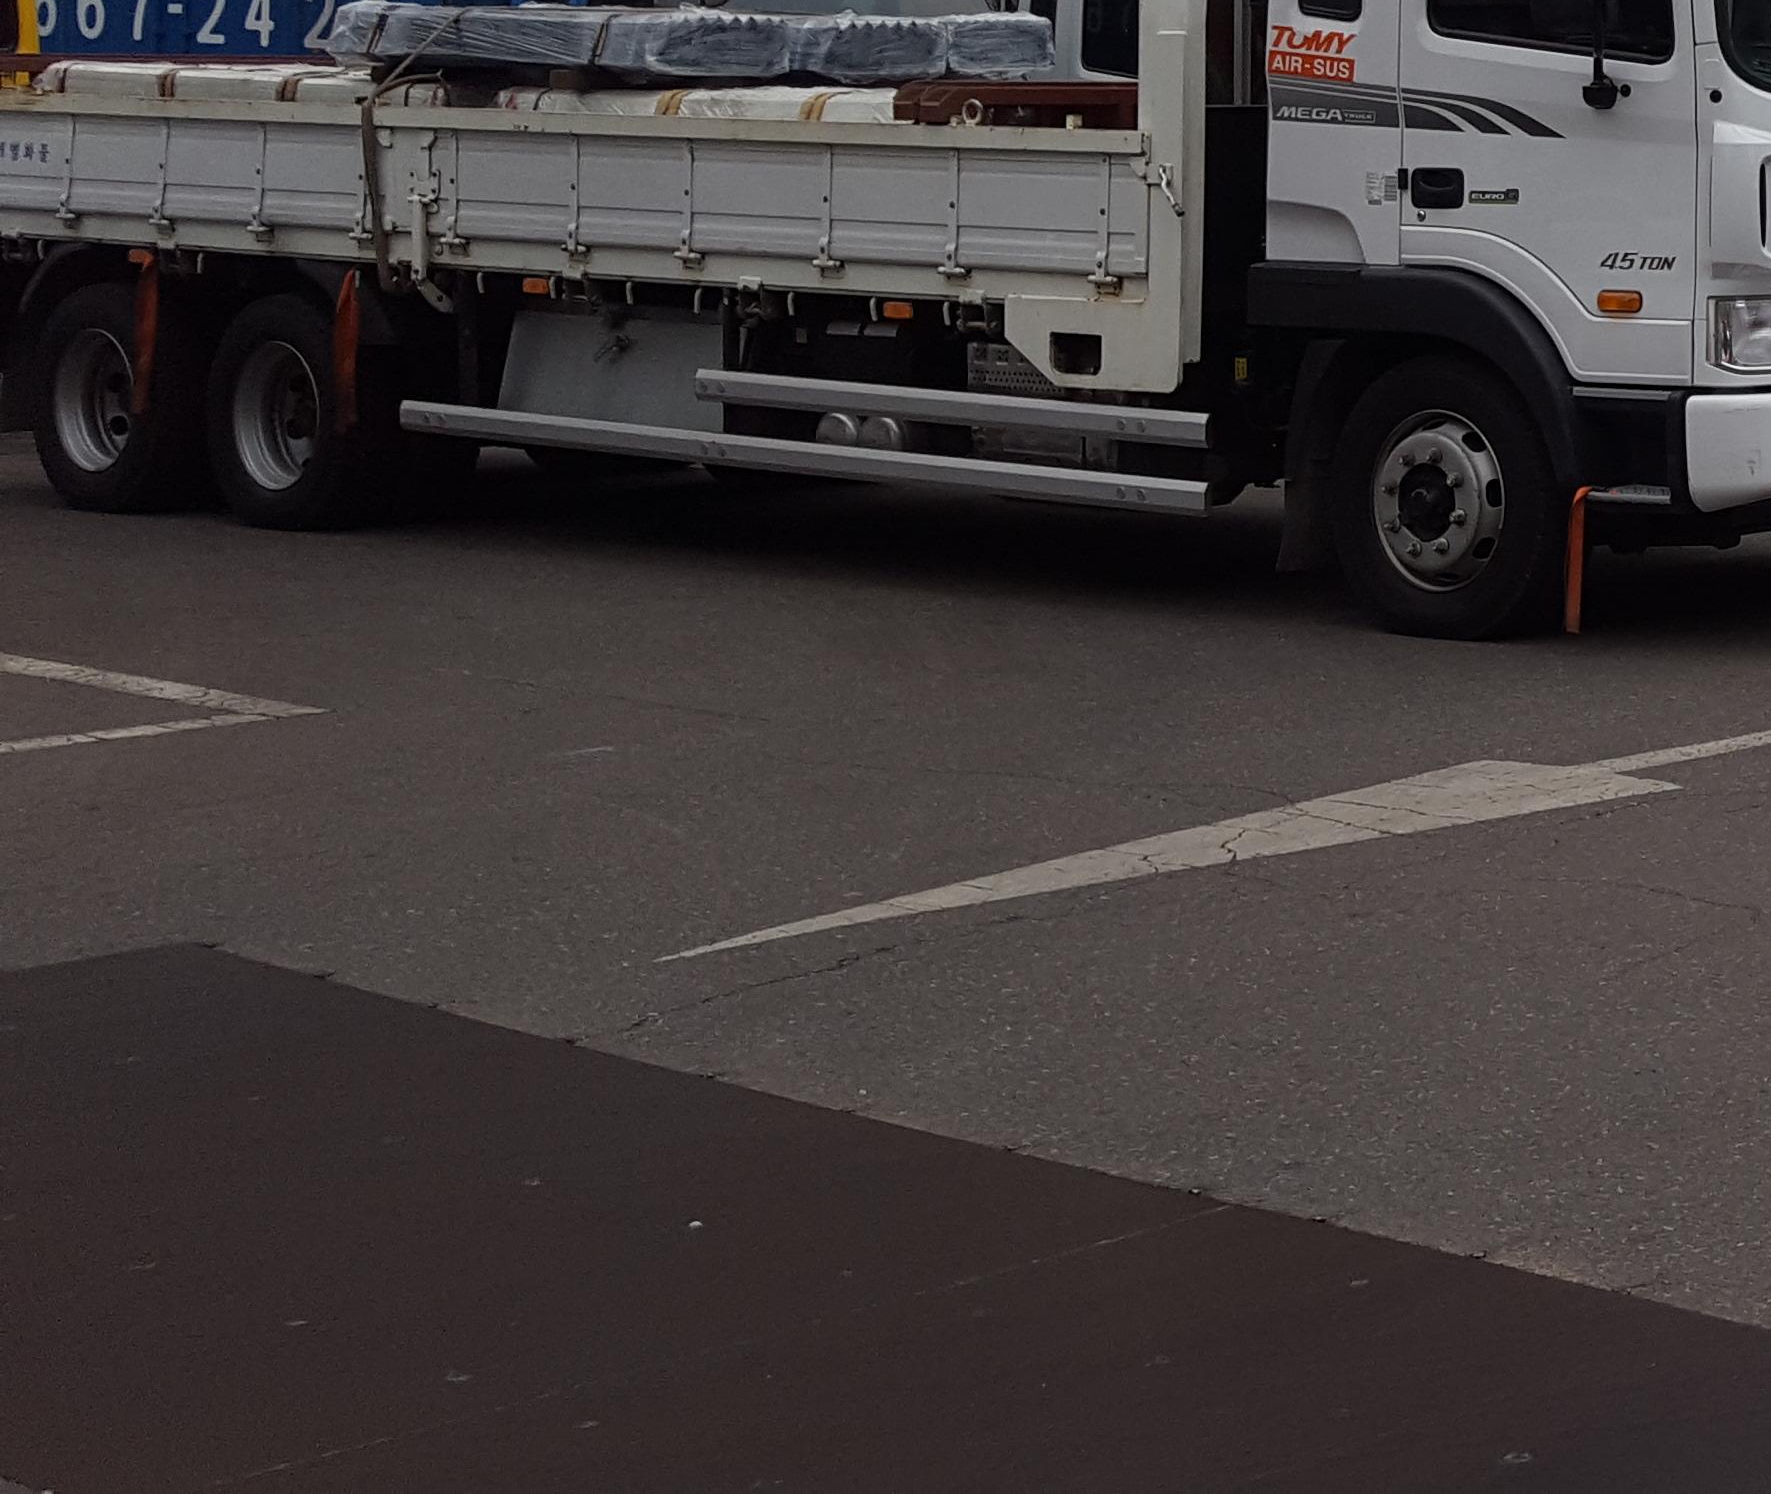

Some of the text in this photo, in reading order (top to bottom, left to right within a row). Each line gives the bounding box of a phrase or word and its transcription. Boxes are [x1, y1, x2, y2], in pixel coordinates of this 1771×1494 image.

[1270, 25, 1357, 56] TOMY
[1271, 55, 1352, 80] AIR-SUS
[1276, 105, 1343, 123] MEGA
[1639, 254, 1677, 271] TON
